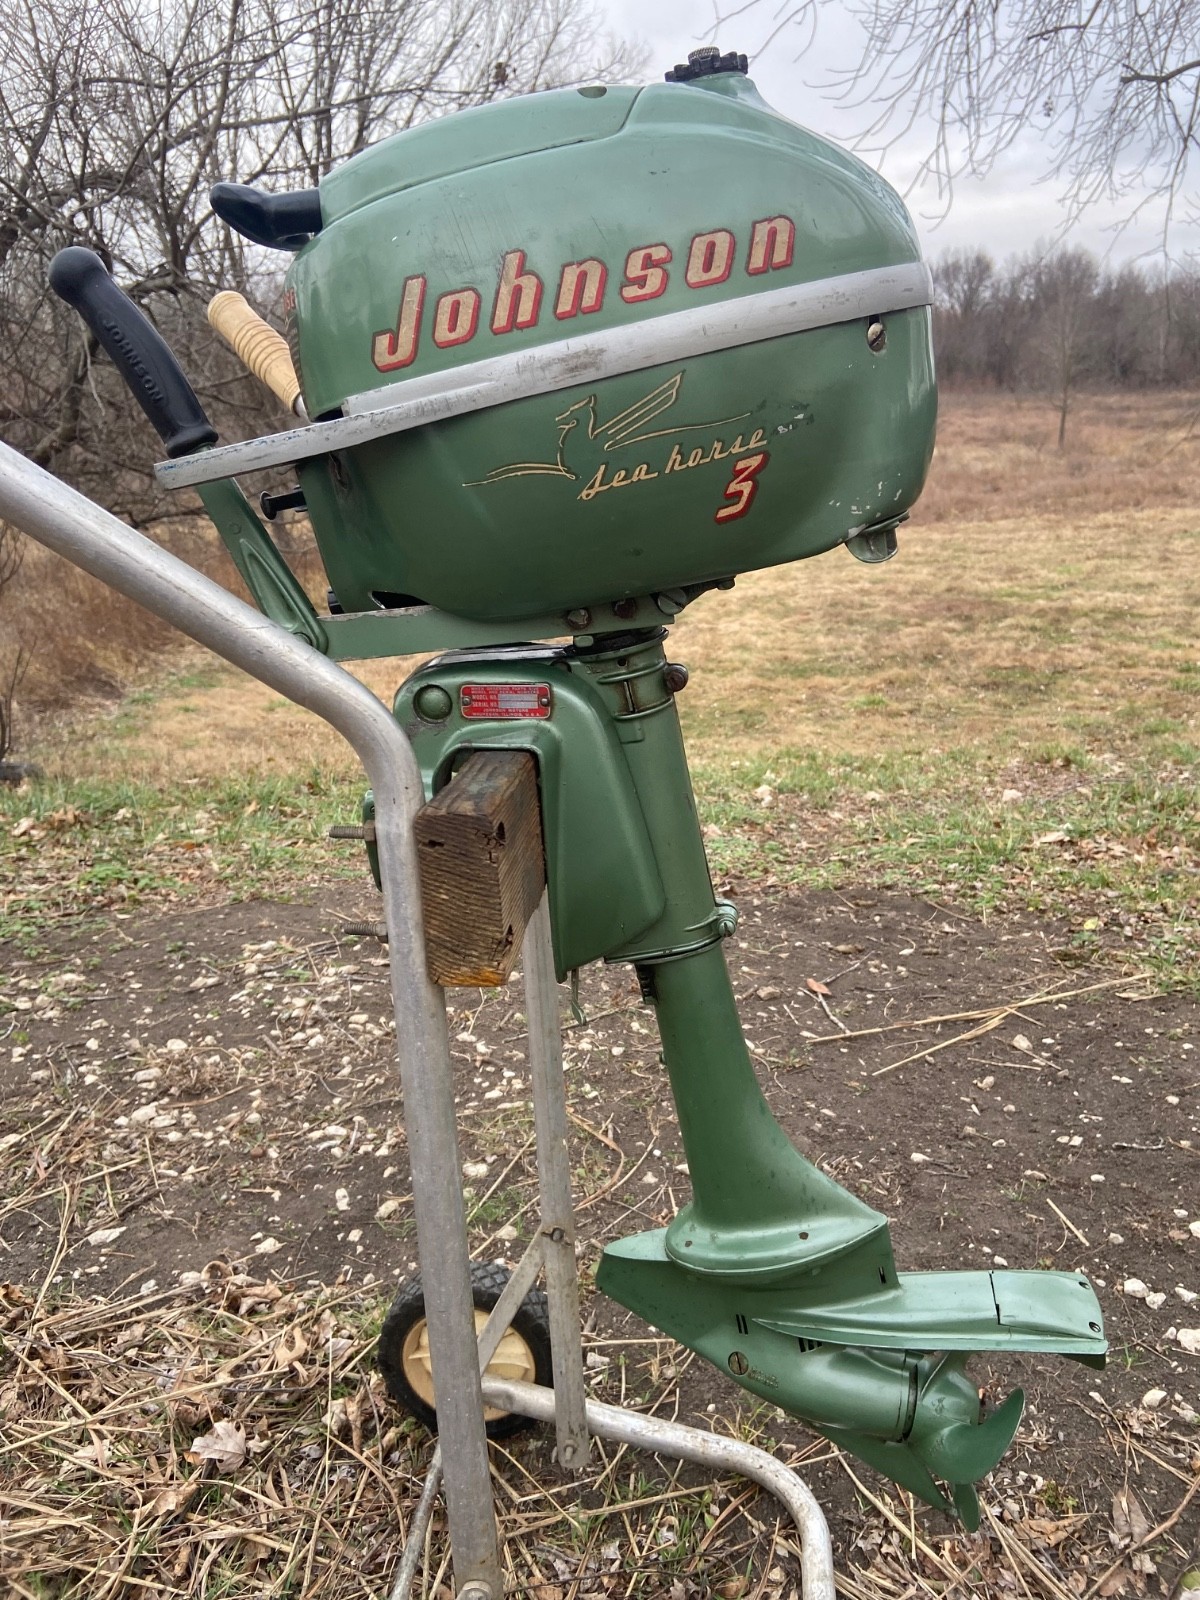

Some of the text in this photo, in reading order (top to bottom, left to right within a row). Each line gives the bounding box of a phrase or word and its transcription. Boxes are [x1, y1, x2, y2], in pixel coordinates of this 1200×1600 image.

[372, 215, 796, 372] Johnson
[103, 321, 164, 404] JOHNSON
[664, 428, 768, 473] horse
[714, 452, 770, 524] 3
